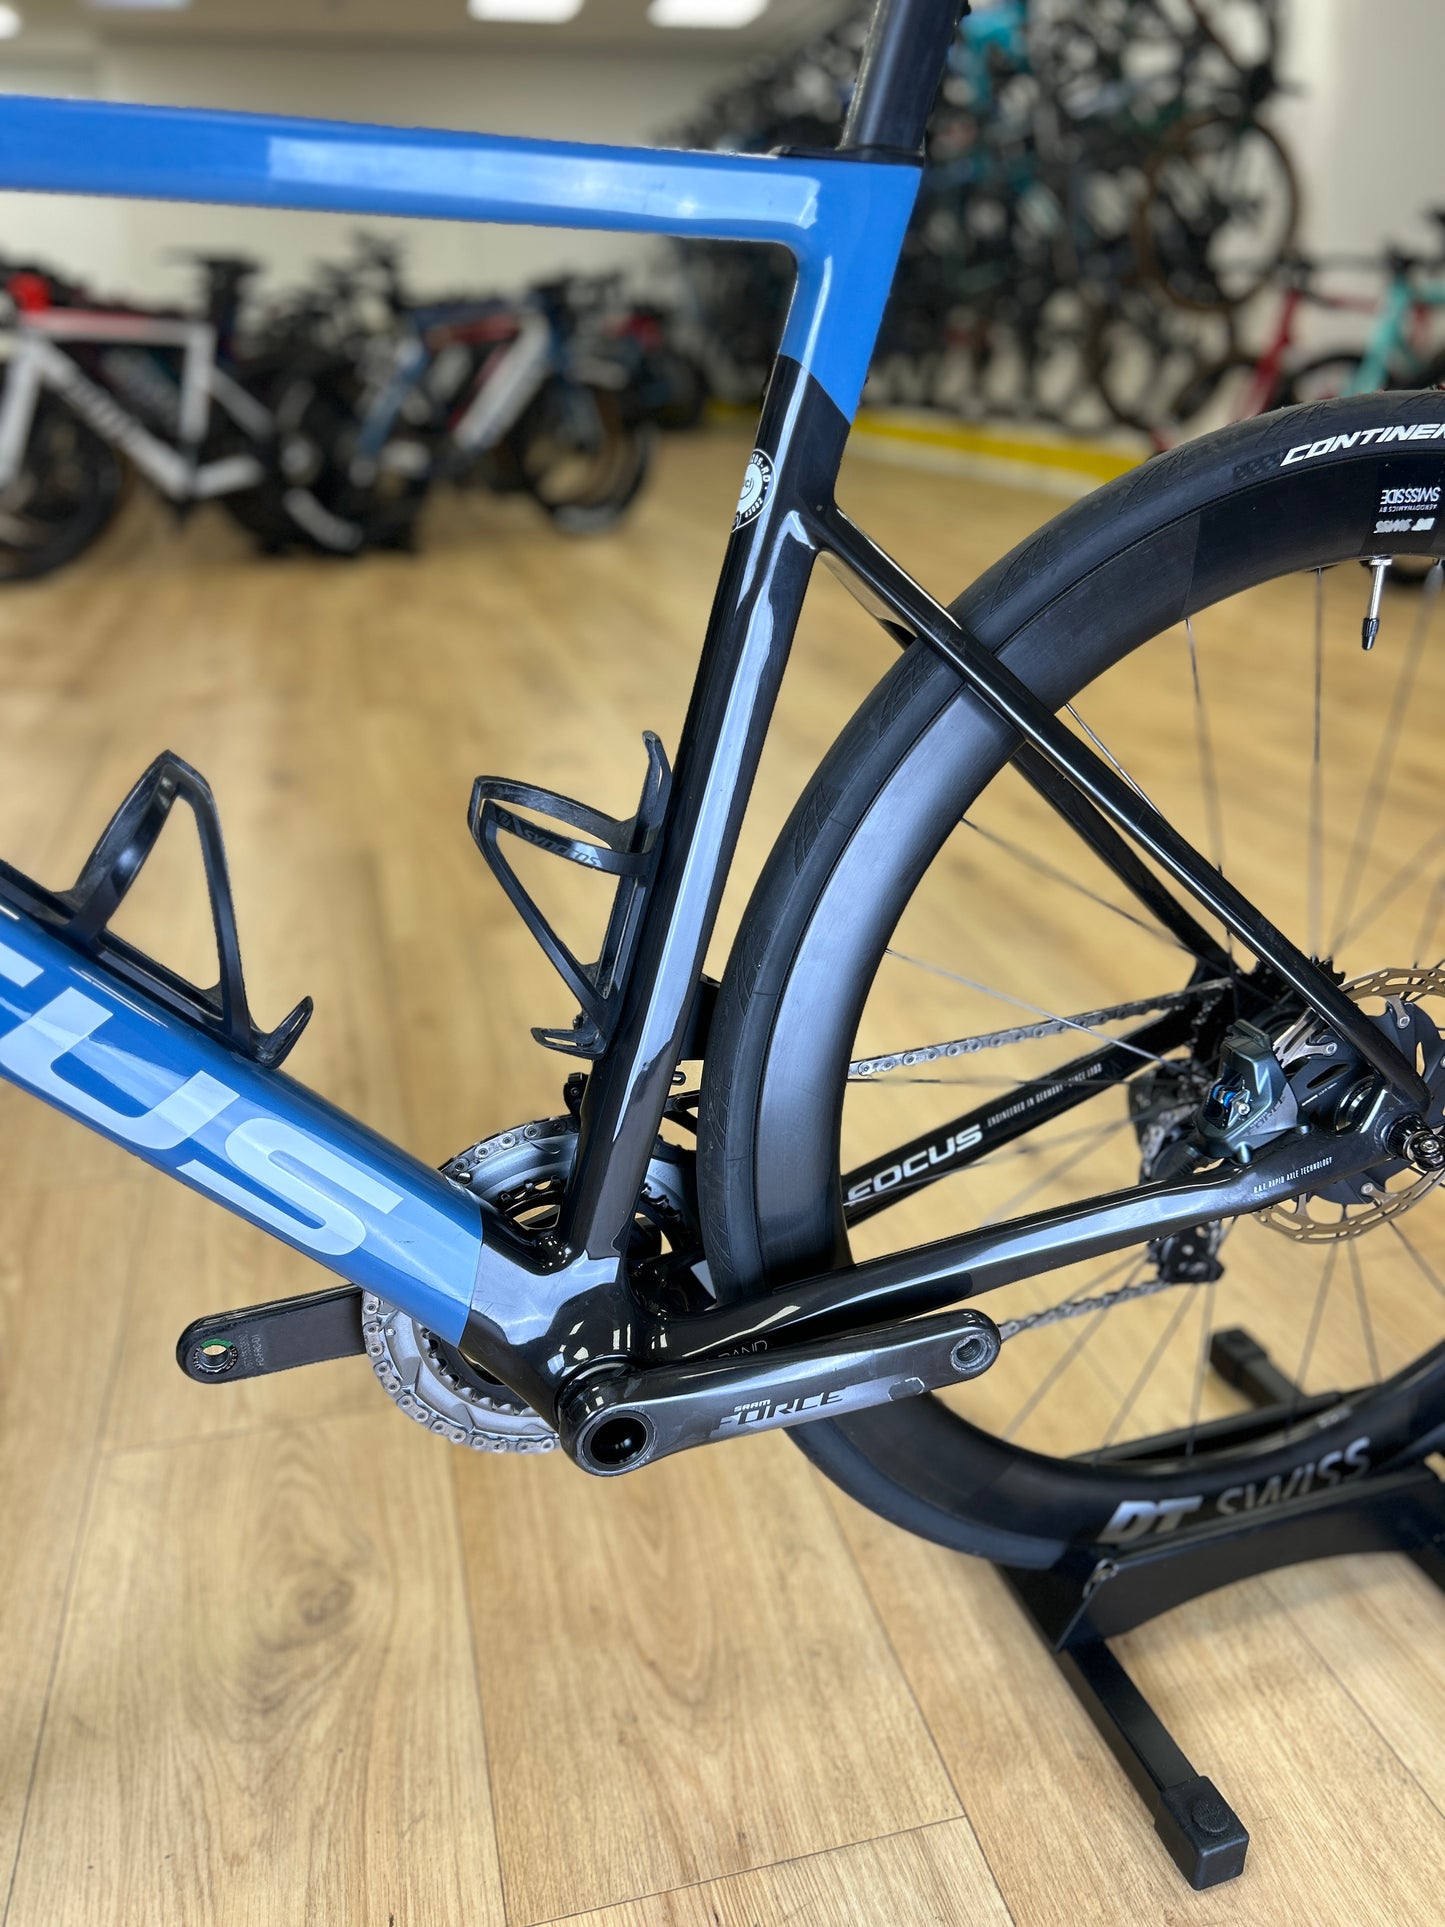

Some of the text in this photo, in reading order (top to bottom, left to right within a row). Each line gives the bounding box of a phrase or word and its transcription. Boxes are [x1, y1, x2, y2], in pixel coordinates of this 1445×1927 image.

[1378, 503, 1438, 514] AERODYNAMICS BY
[0, 940, 403, 1256] US
[847, 1123, 984, 1207] FOCUS
[1268, 1176, 1284, 1188] RAPID
[1286, 1169, 1299, 1181] AXLE
[1300, 1157, 1333, 1176] TECHNOLOGY
[713, 1385, 846, 1431] FORCE
[733, 1398, 772, 1412] SRAM
[1097, 1495, 1204, 1545] DT
